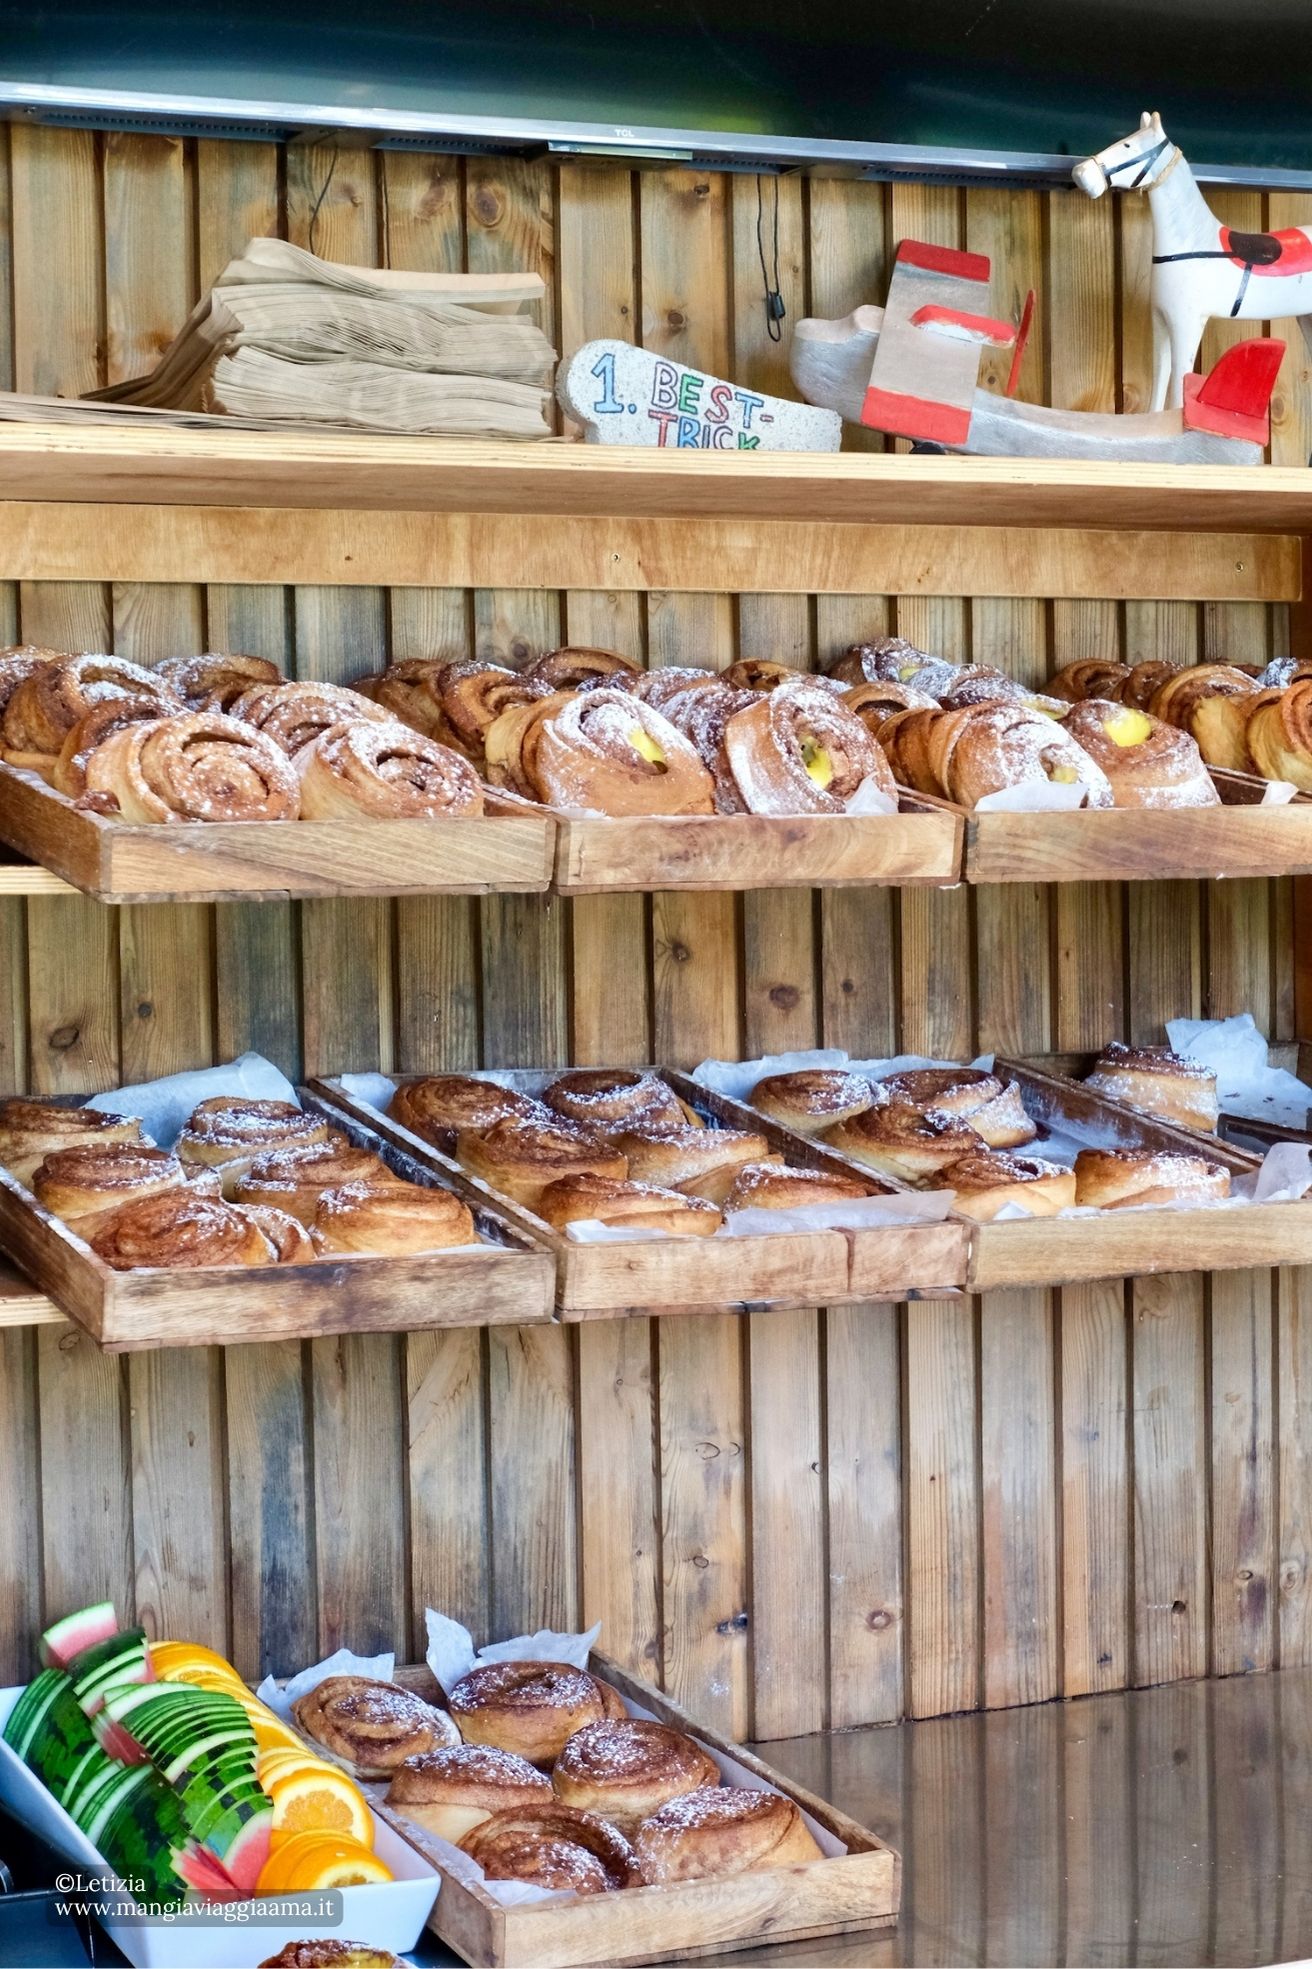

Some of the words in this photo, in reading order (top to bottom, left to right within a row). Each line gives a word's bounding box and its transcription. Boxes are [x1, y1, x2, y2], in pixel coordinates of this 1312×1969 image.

[614, 128, 635, 138] TCL
[591, 352, 637, 415] 1.
[651, 361, 775, 429] BEST-
[648, 409, 761, 450] TRICK
